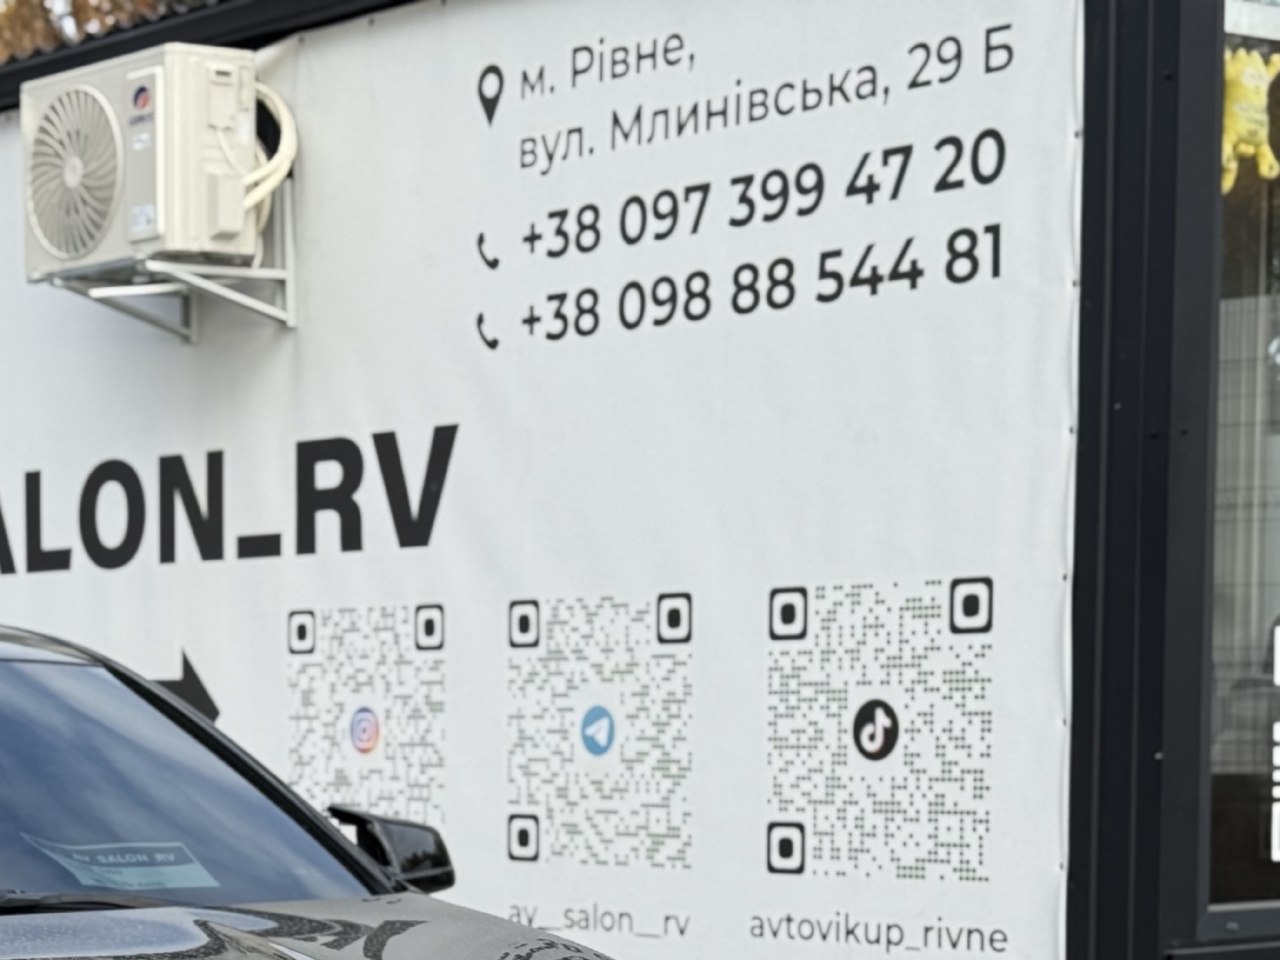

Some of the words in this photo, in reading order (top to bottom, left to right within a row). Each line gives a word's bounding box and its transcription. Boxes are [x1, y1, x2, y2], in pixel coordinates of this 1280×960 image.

[520, 127, 595, 176] вул.
[611, 66, 891, 150] Млинівська,
[907, 36, 963, 90] 29
[984, 24, 1014, 74] Б
[521, 69, 555, 100] м.
[572, 33, 696, 89] Рівне,
[522, 204, 601, 260] +38
[619, 182, 712, 247] 097
[728, 163, 825, 229] 399
[845, 144, 914, 205] 47
[933, 128, 1006, 193] 20
[522, 287, 600, 341] +38
[618, 270, 712, 331] 098
[730, 257, 796, 315] 88
[815, 238, 925, 304] 544
[944, 224, 1002, 285] 81
[508, 902, 690, 938] av_salon_rv
[749, 911, 1009, 954] avtovikup_rivne
